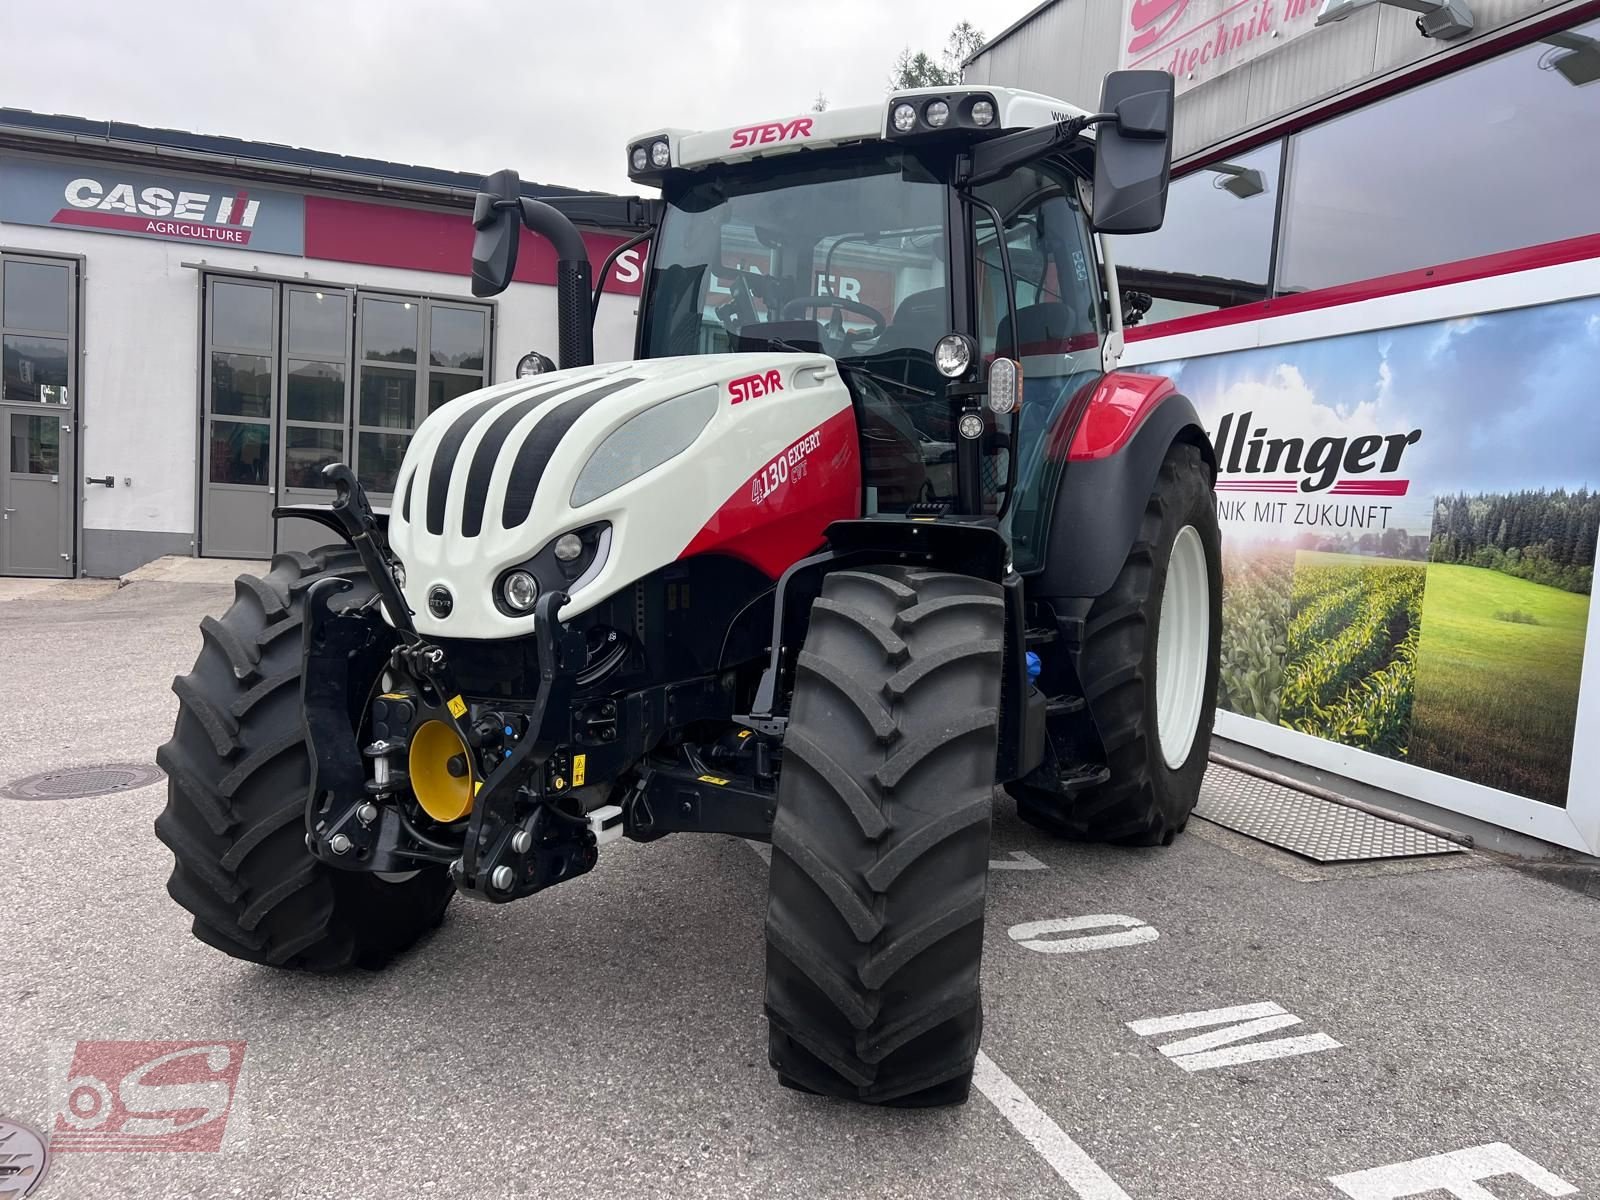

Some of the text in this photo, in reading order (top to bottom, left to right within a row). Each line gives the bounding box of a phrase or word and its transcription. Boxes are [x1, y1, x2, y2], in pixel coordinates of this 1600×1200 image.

[729, 118, 813, 149] STEYR
[64, 178, 211, 222] CASE
[146, 221, 243, 243] AGRICULTURE
[728, 369, 785, 405] STEYR
[751, 430, 821, 505] 4130 EXPERT
[1206, 411, 1423, 493] llinger
[1217, 501, 1393, 530] NIK MIT ZUKUNFT
